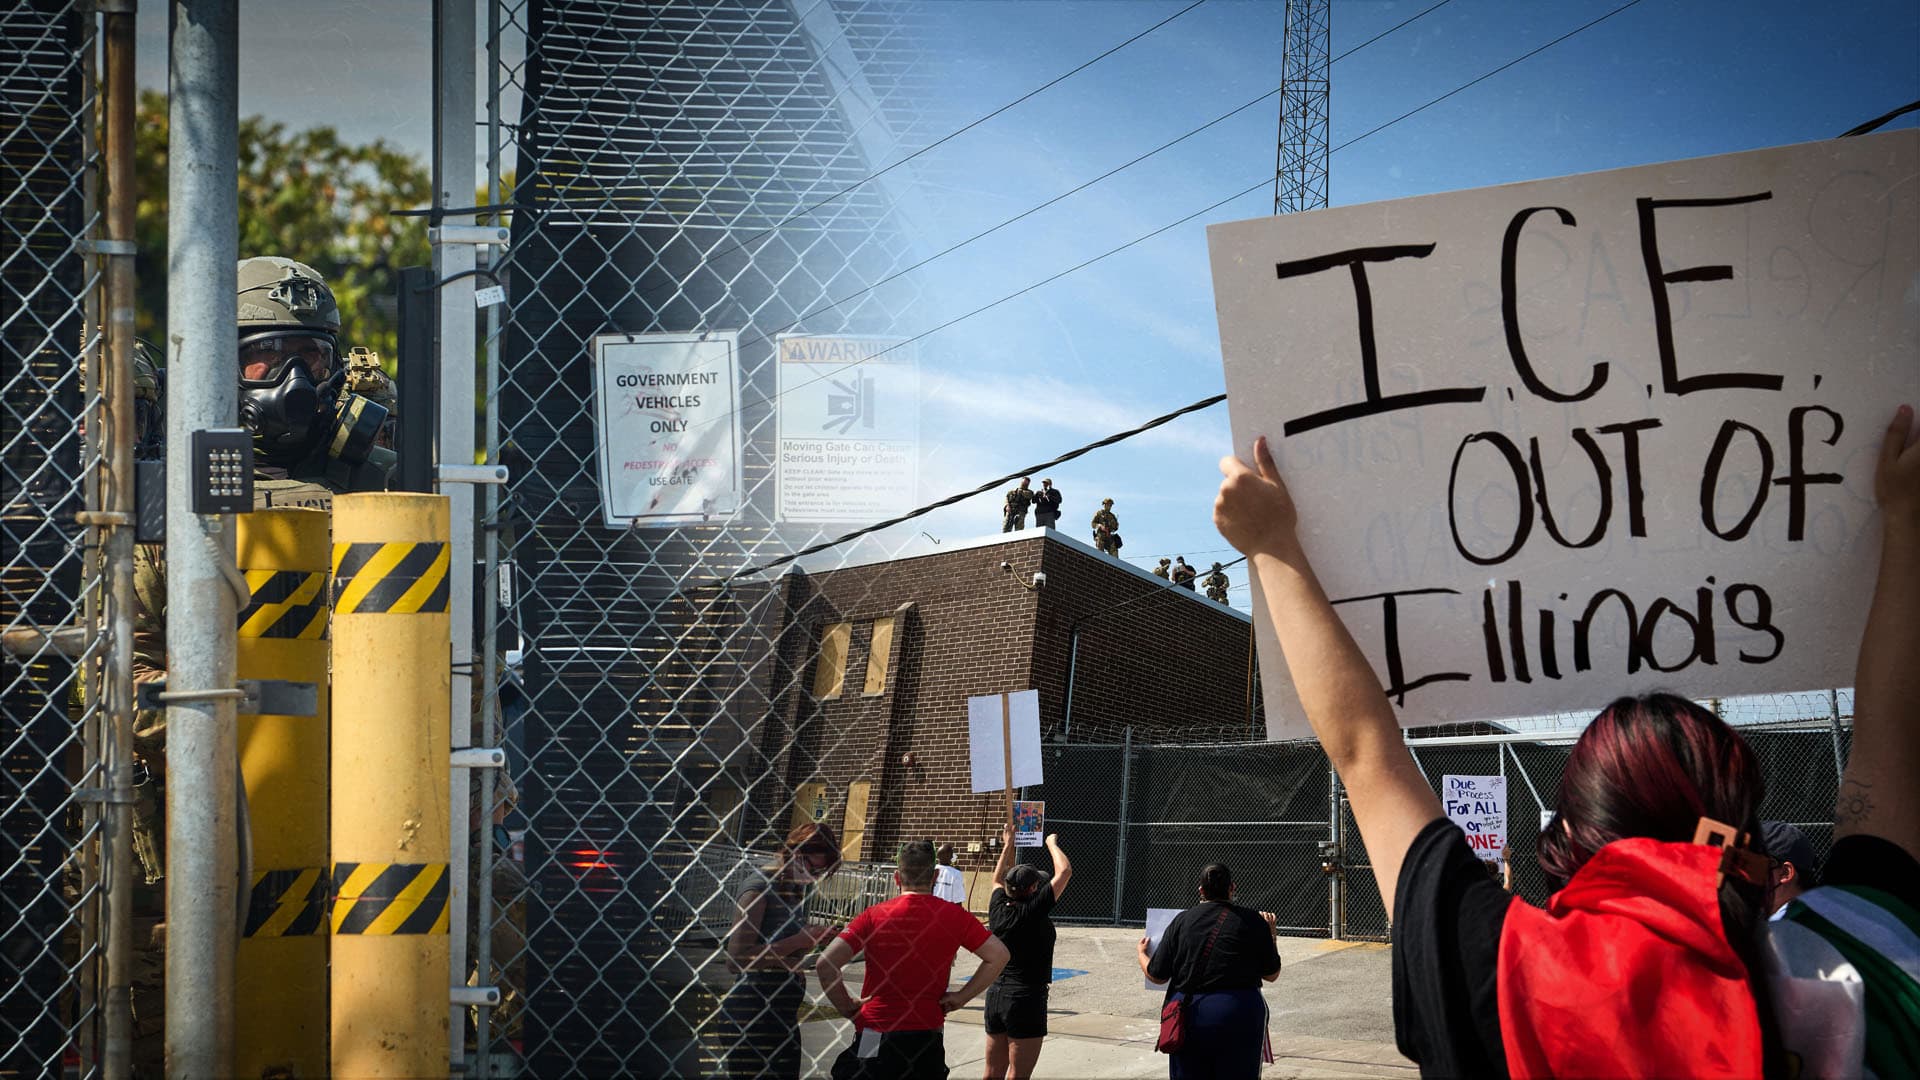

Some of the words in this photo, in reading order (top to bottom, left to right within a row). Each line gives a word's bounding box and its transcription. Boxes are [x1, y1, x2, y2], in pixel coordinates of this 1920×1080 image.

[806, 341, 910, 361] WARNING
[616, 372, 719, 387] GOVERNMENT
[636, 395, 701, 409] VEHICLES
[650, 420, 688, 434] ONLY
[663, 442, 678, 452] NO
[783, 441, 823, 454] Moving
[825, 441, 851, 452] Gate
[853, 442, 875, 452] Can
[783, 453, 824, 463] Serious
[827, 454, 858, 465] Injury
[860, 455, 873, 464] or
[649, 476, 667, 486] USE
[669, 475, 693, 486] GATE
[1448, 418, 1662, 565] OUT
[1329, 575, 1786, 707] Illinois
[1450, 778, 1477, 790] Due
[1447, 800, 1470, 816] For
[1474, 801, 1501, 815] ALL
